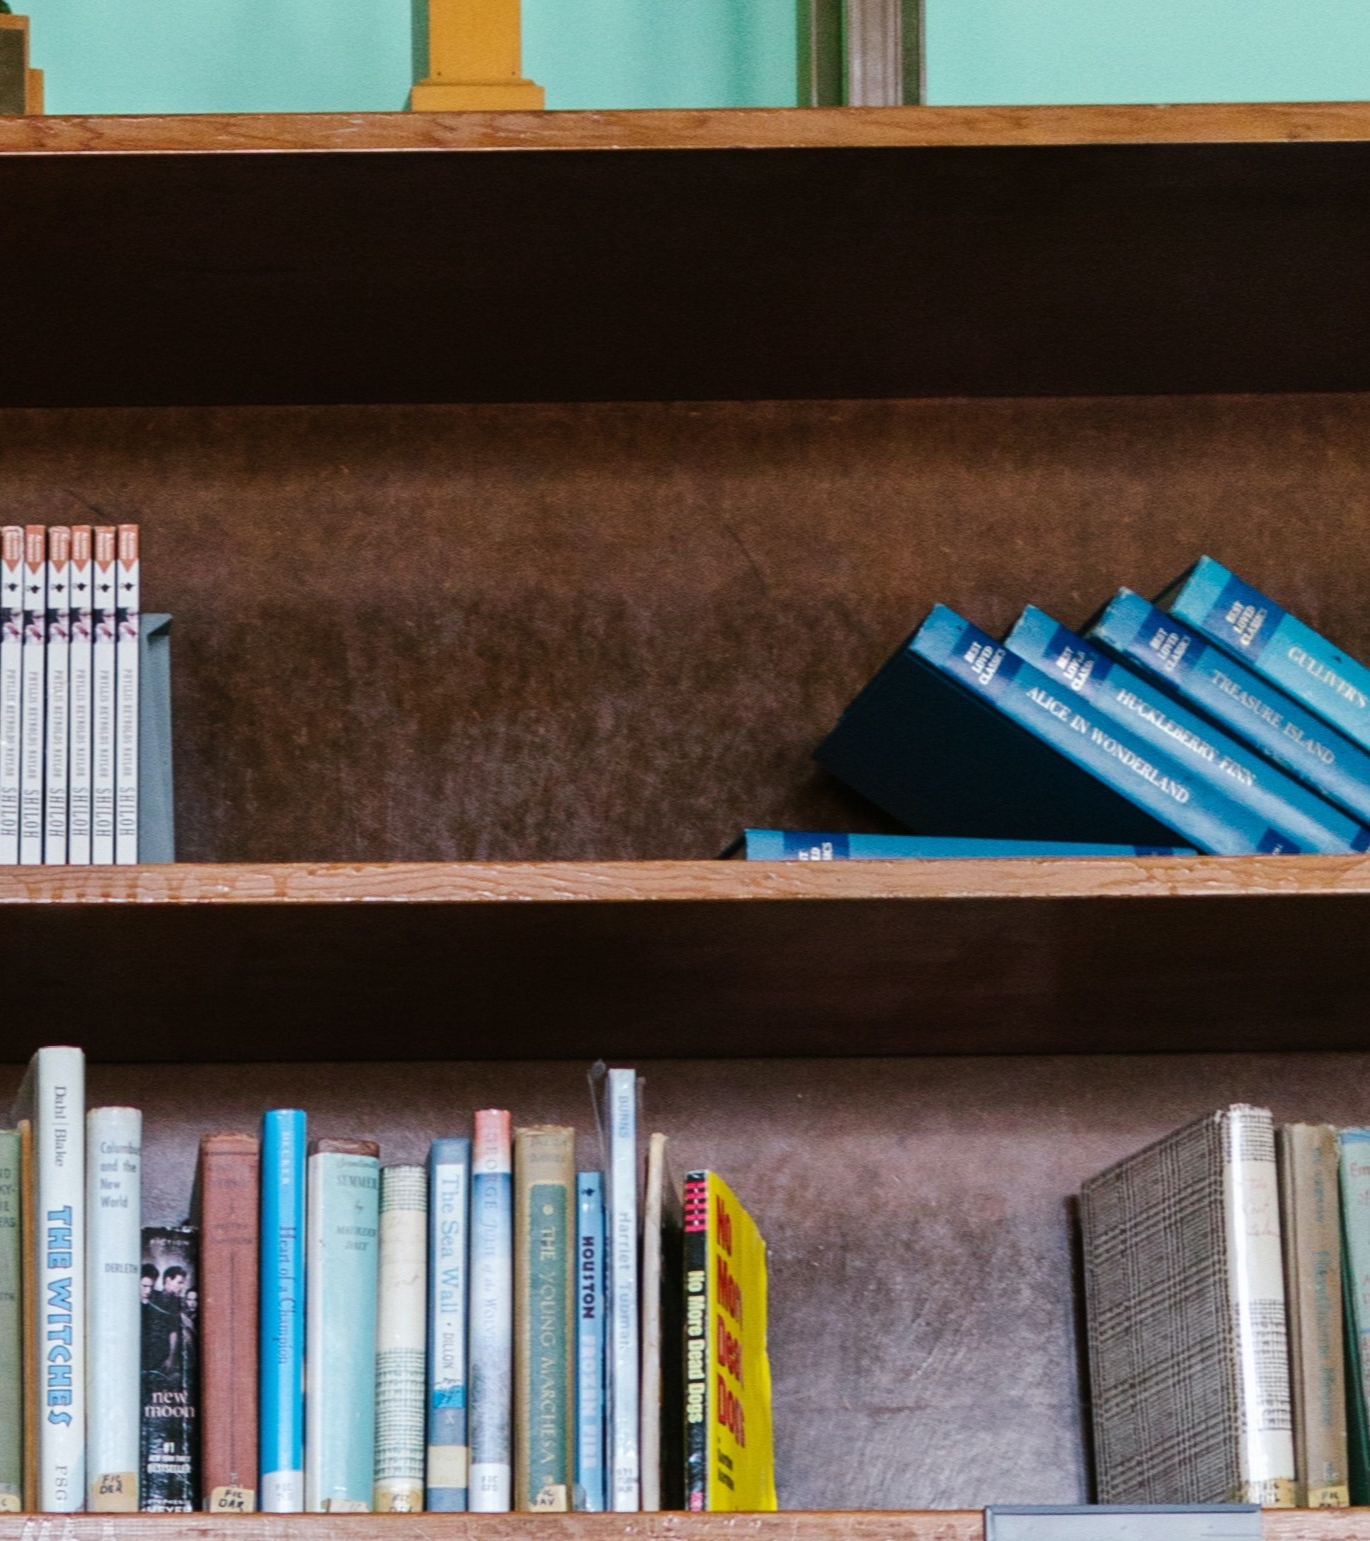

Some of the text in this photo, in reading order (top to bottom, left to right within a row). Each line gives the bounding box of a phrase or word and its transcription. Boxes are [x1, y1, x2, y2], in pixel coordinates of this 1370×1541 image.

[1211, 669, 1335, 766] TREASURE ISLAND
[1287, 644, 1369, 711] GULLIVER'S
[1026, 686, 1191, 805] ALICE IN WONDERLAND
[1115, 687, 1257, 787] HUCKLEBERRY FINN
[54, 1085, 67, 1168] Dahl Blake
[439, 1174, 460, 1314] The Sea Wall
[46, 1205, 73, 1428] THE WITCHES
[443, 1332, 455, 1369] DILLON
[685, 1270, 705, 1423] No More Dead Dogs
